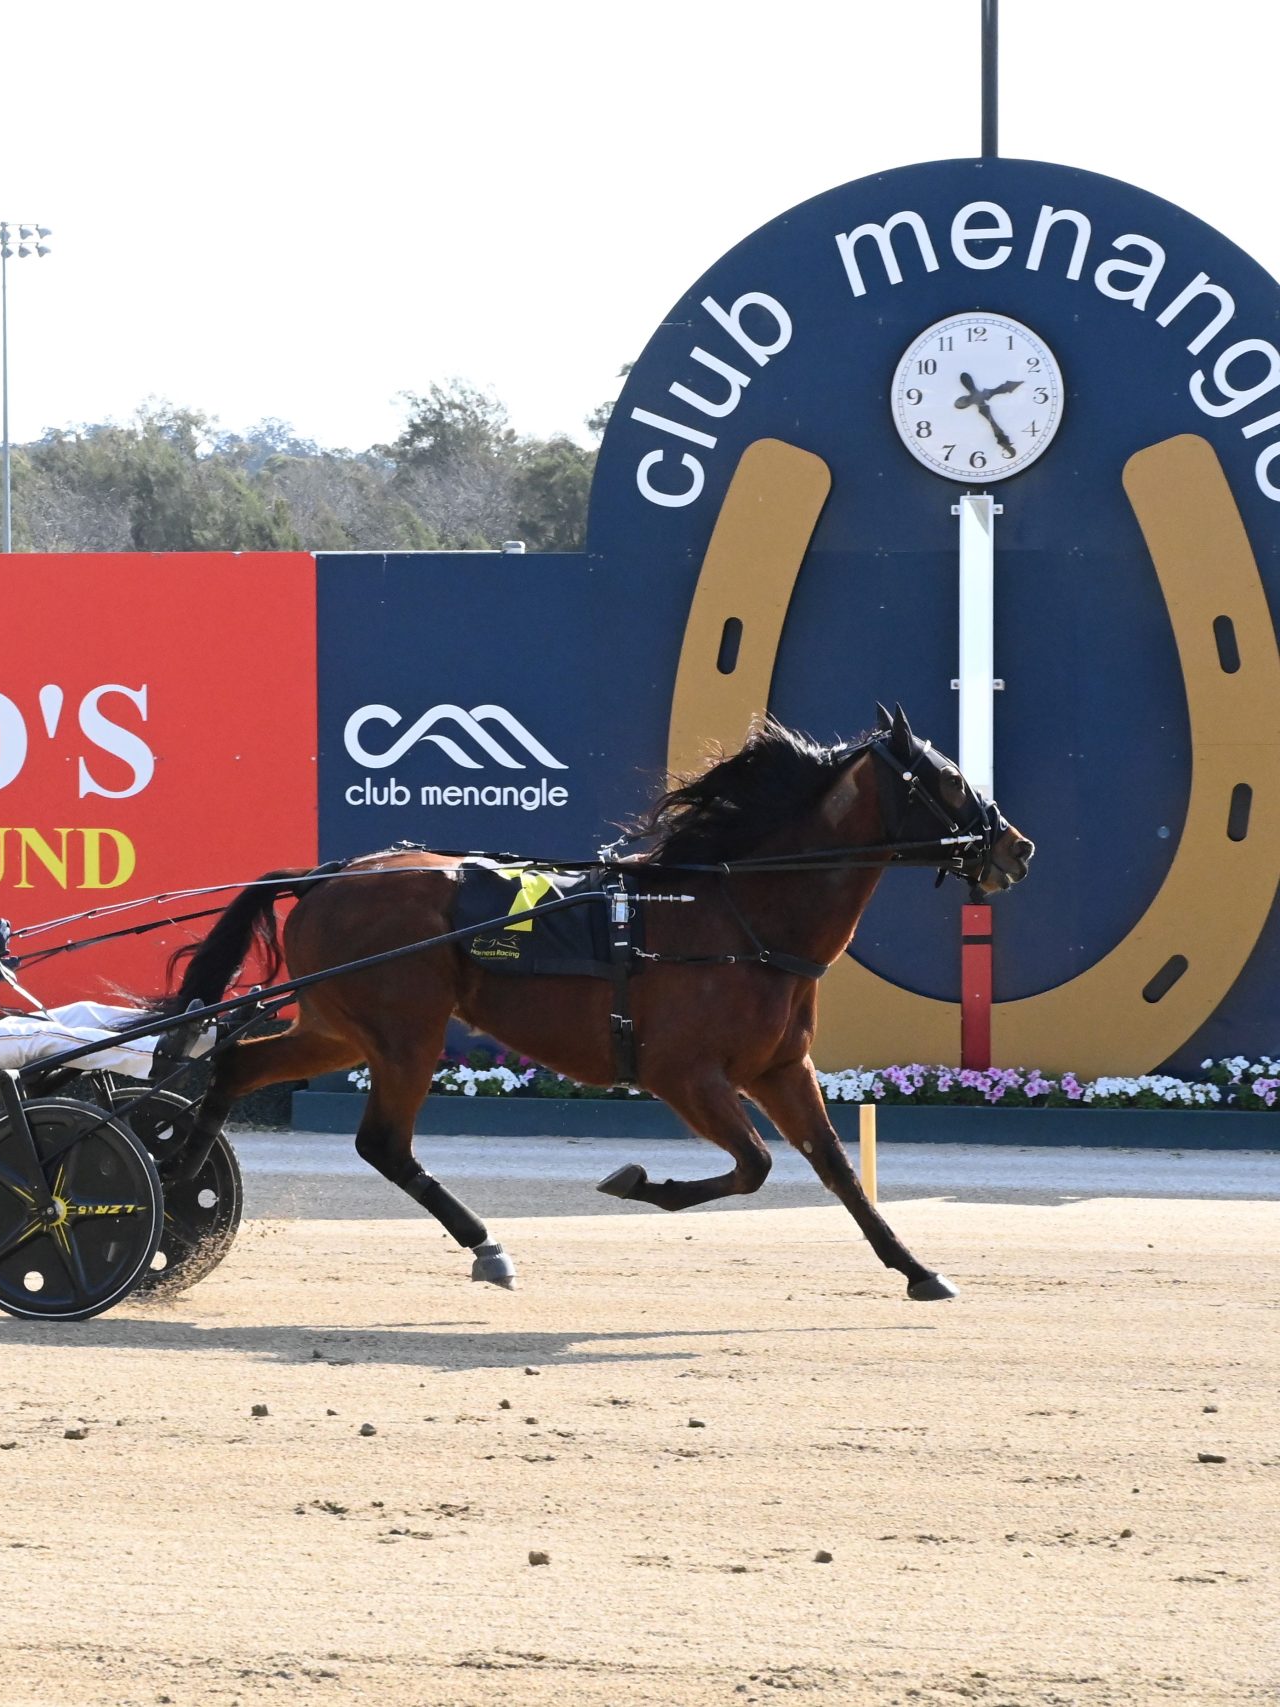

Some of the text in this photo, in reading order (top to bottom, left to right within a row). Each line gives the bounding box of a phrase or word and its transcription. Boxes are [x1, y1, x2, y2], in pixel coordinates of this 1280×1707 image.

[966, 326, 988, 343] 12
[1006, 335, 1014, 350] 1
[938, 336, 954, 351] 11
[917, 359, 937, 375] 10
[1026, 357, 1041, 374] 2
[636, 291, 792, 508] club
[906, 388, 923, 405] 9
[1033, 387, 1049, 404] 3
[916, 420, 932, 438] 8
[1021, 420, 1041, 437] 4
[942, 444, 957, 461] 7
[969, 451, 987, 468] 6
[344, 777, 569, 811] club menangle
[496, 949, 520, 959] Racing
